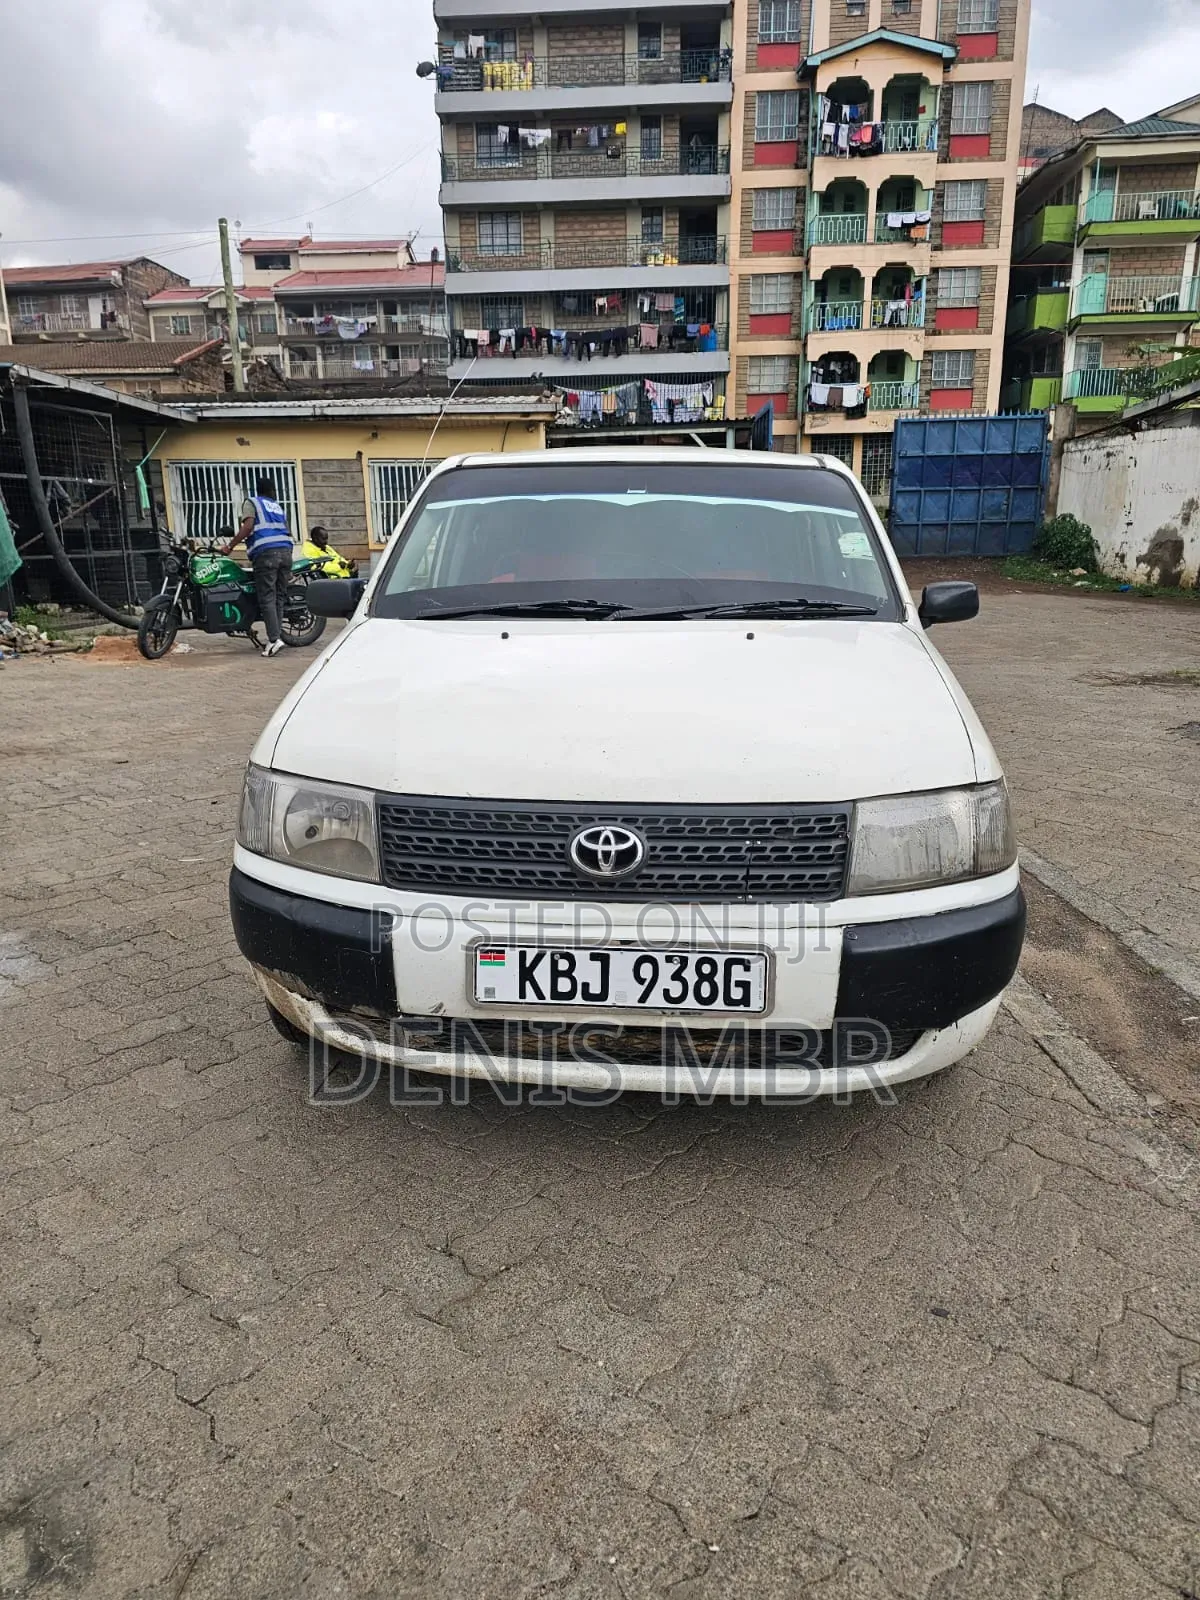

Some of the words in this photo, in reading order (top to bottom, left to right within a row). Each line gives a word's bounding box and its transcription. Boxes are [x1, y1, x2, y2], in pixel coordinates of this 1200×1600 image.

[195, 562, 220, 579] spiro
[518, 950, 611, 1002] KBJ
[632, 954, 752, 1008] 938G
